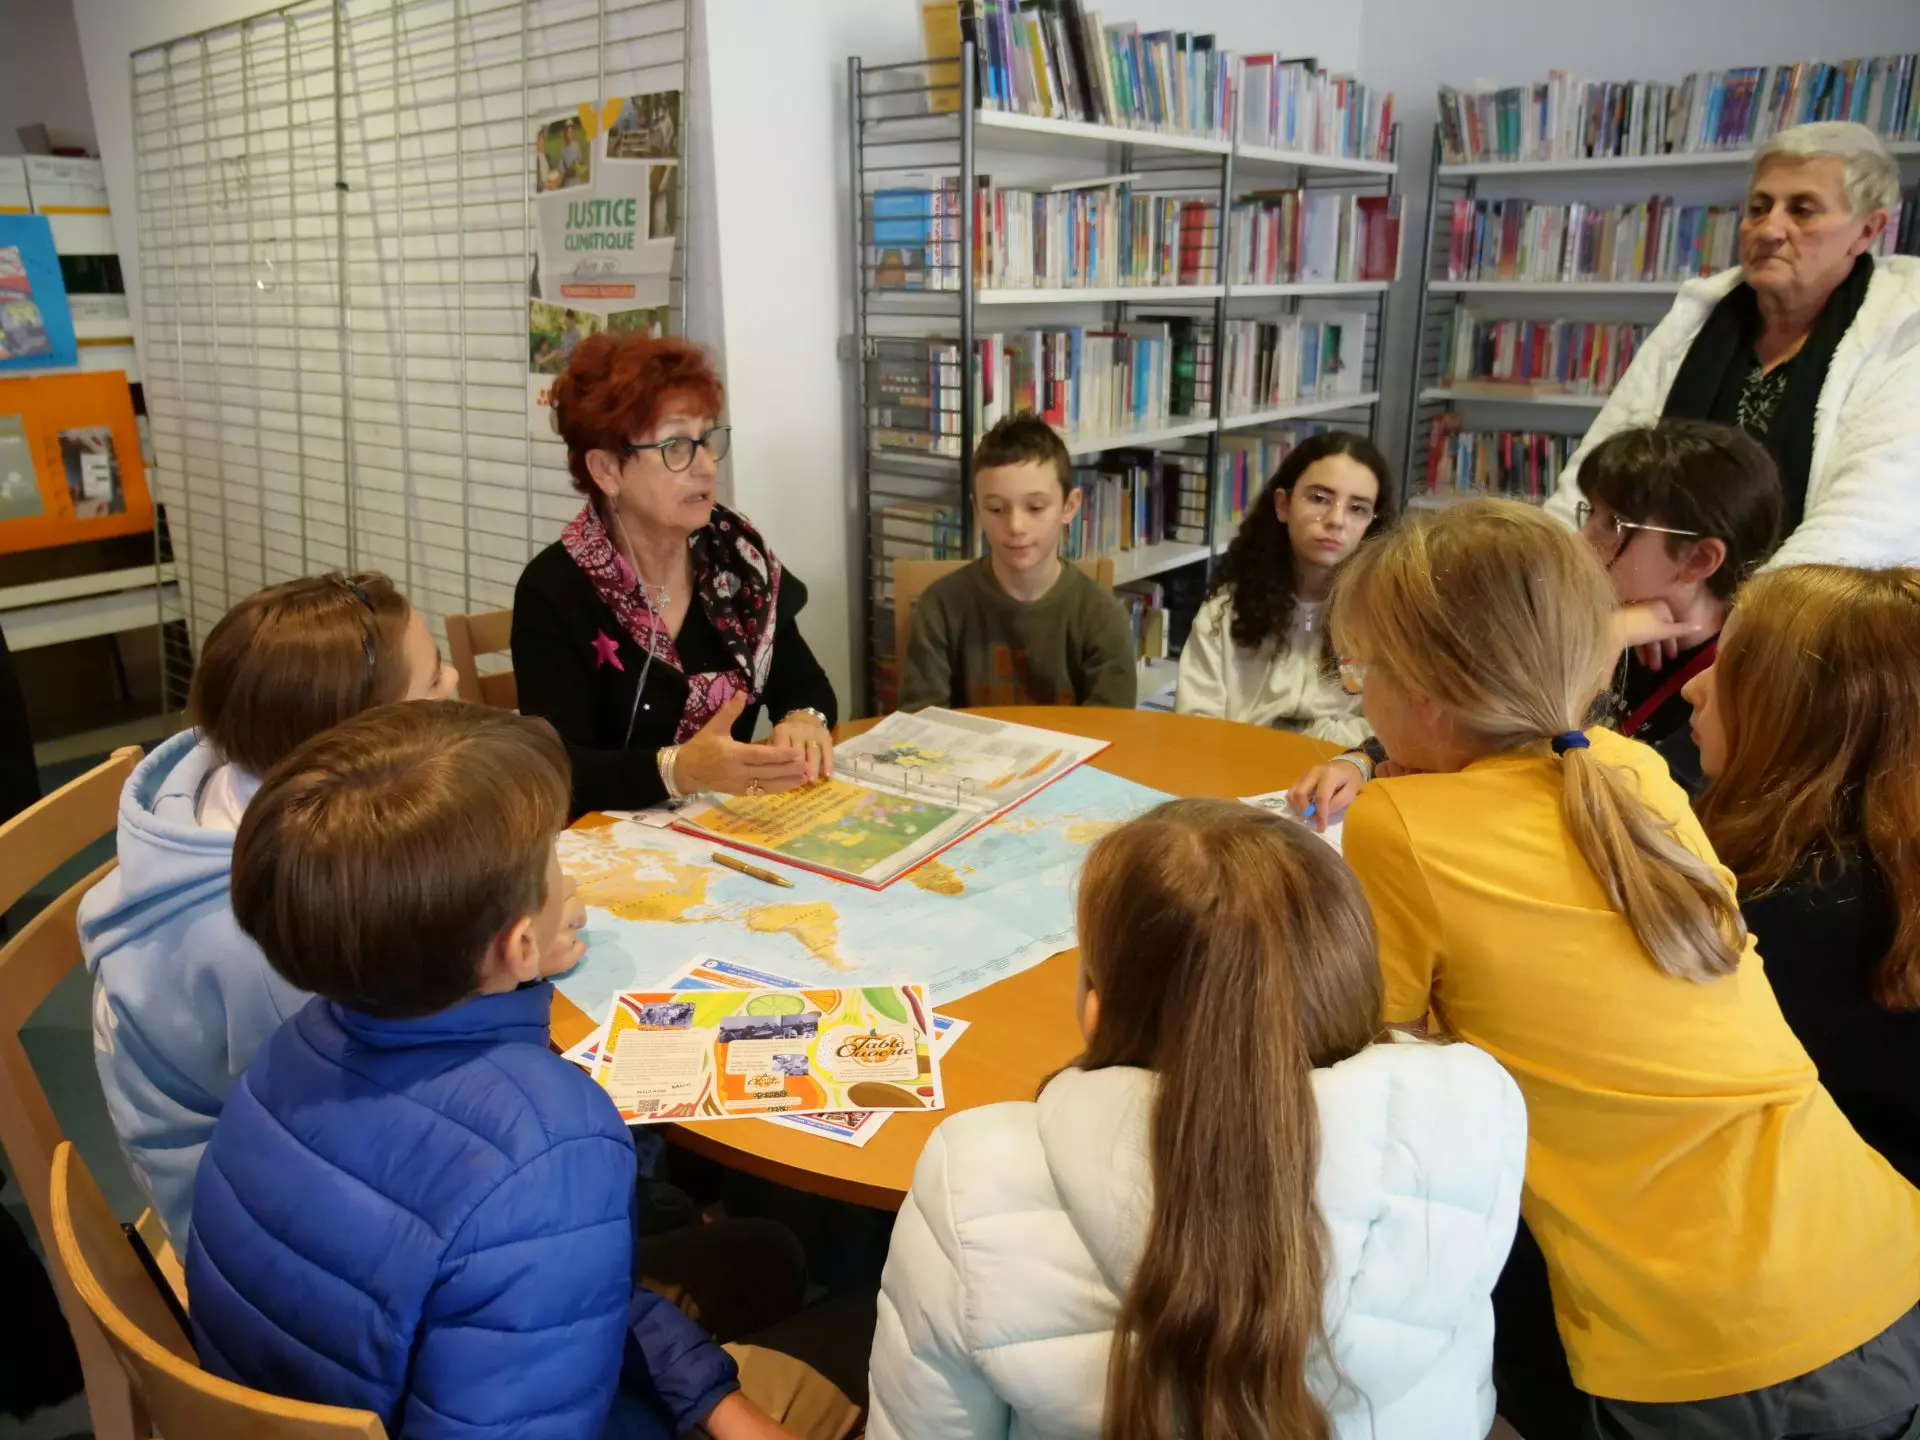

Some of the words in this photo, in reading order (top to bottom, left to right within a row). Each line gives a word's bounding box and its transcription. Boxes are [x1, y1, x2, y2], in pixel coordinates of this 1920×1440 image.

[565, 198, 636, 229] JUSTICE
[564, 232, 635, 251] CLIMATIQUE
[836, 1044, 913, 1057] Ouverte
[854, 1037, 904, 1049] Table
